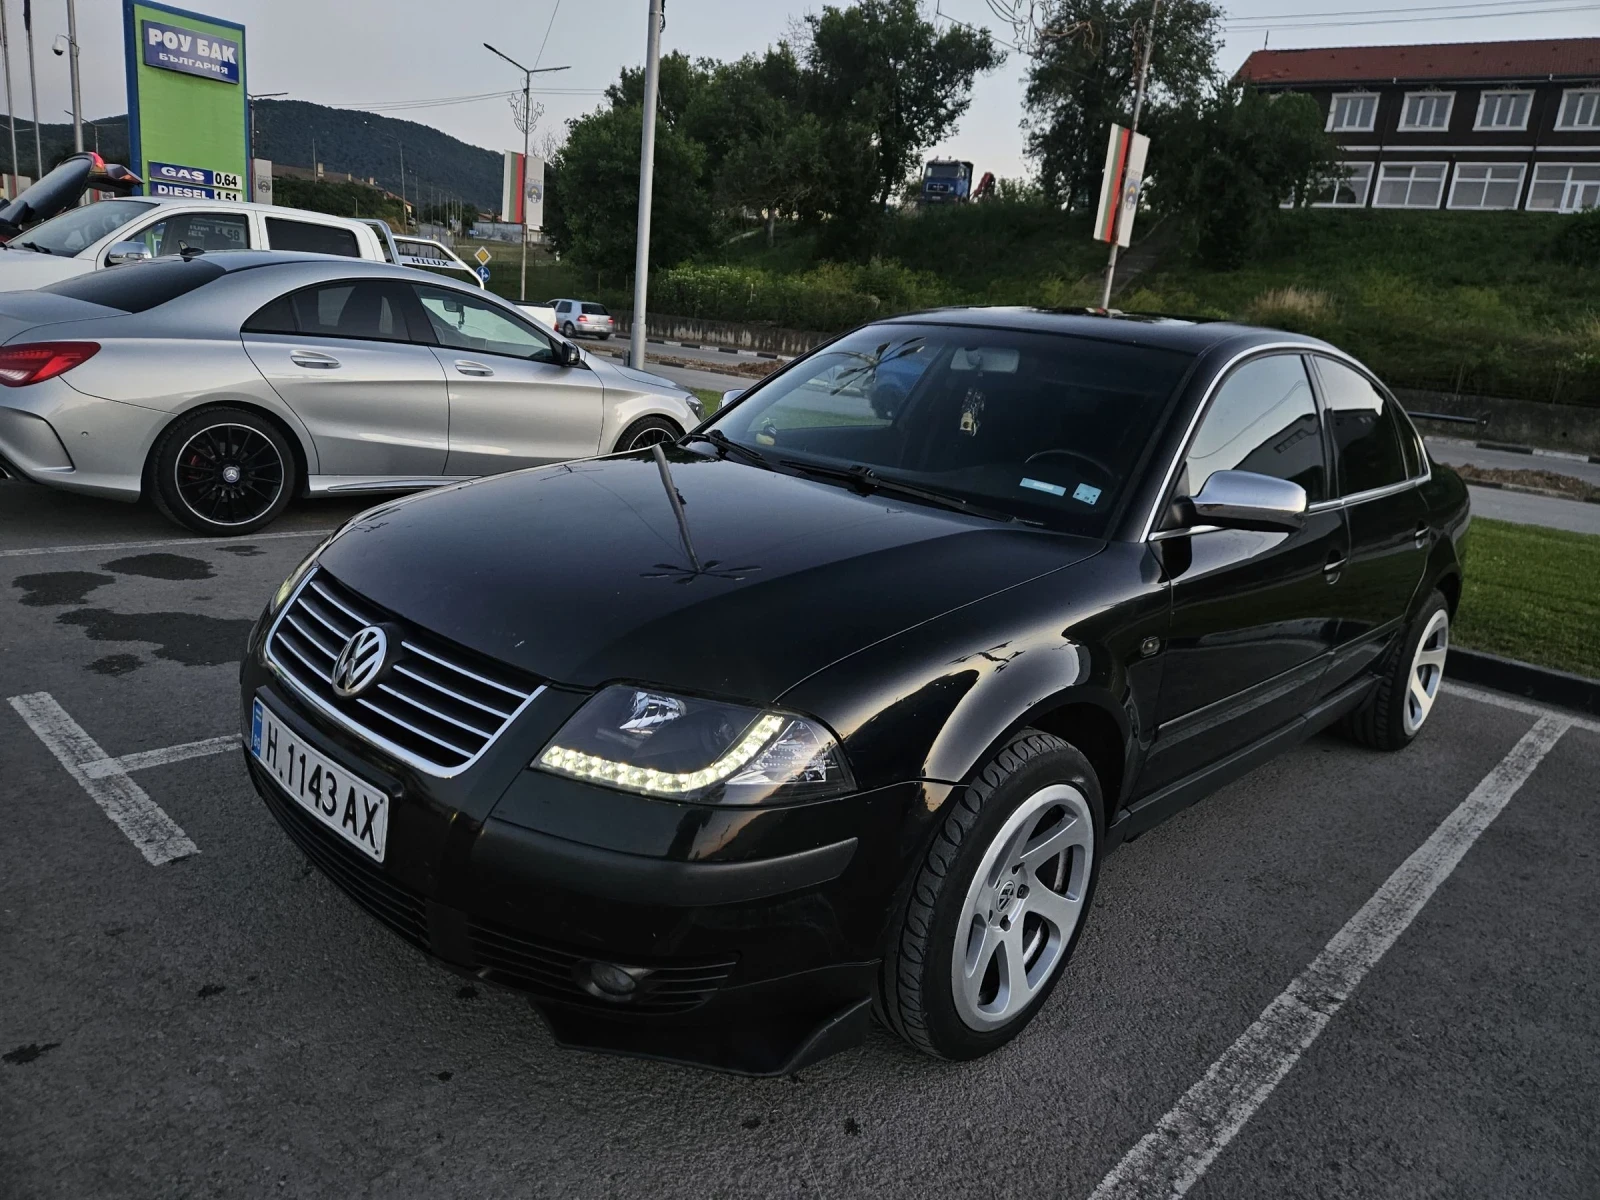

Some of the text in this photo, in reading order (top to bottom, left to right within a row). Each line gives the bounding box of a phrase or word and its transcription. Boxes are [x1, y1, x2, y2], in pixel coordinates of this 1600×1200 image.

[148, 28, 236, 64] РОУ БАК
[158, 52, 228, 75] БЪЛГАРИЯ
[161, 166, 237, 187] GAS 0.64
[157, 185, 237, 201] DIESEL 151
[411, 257, 449, 267] HILUX
